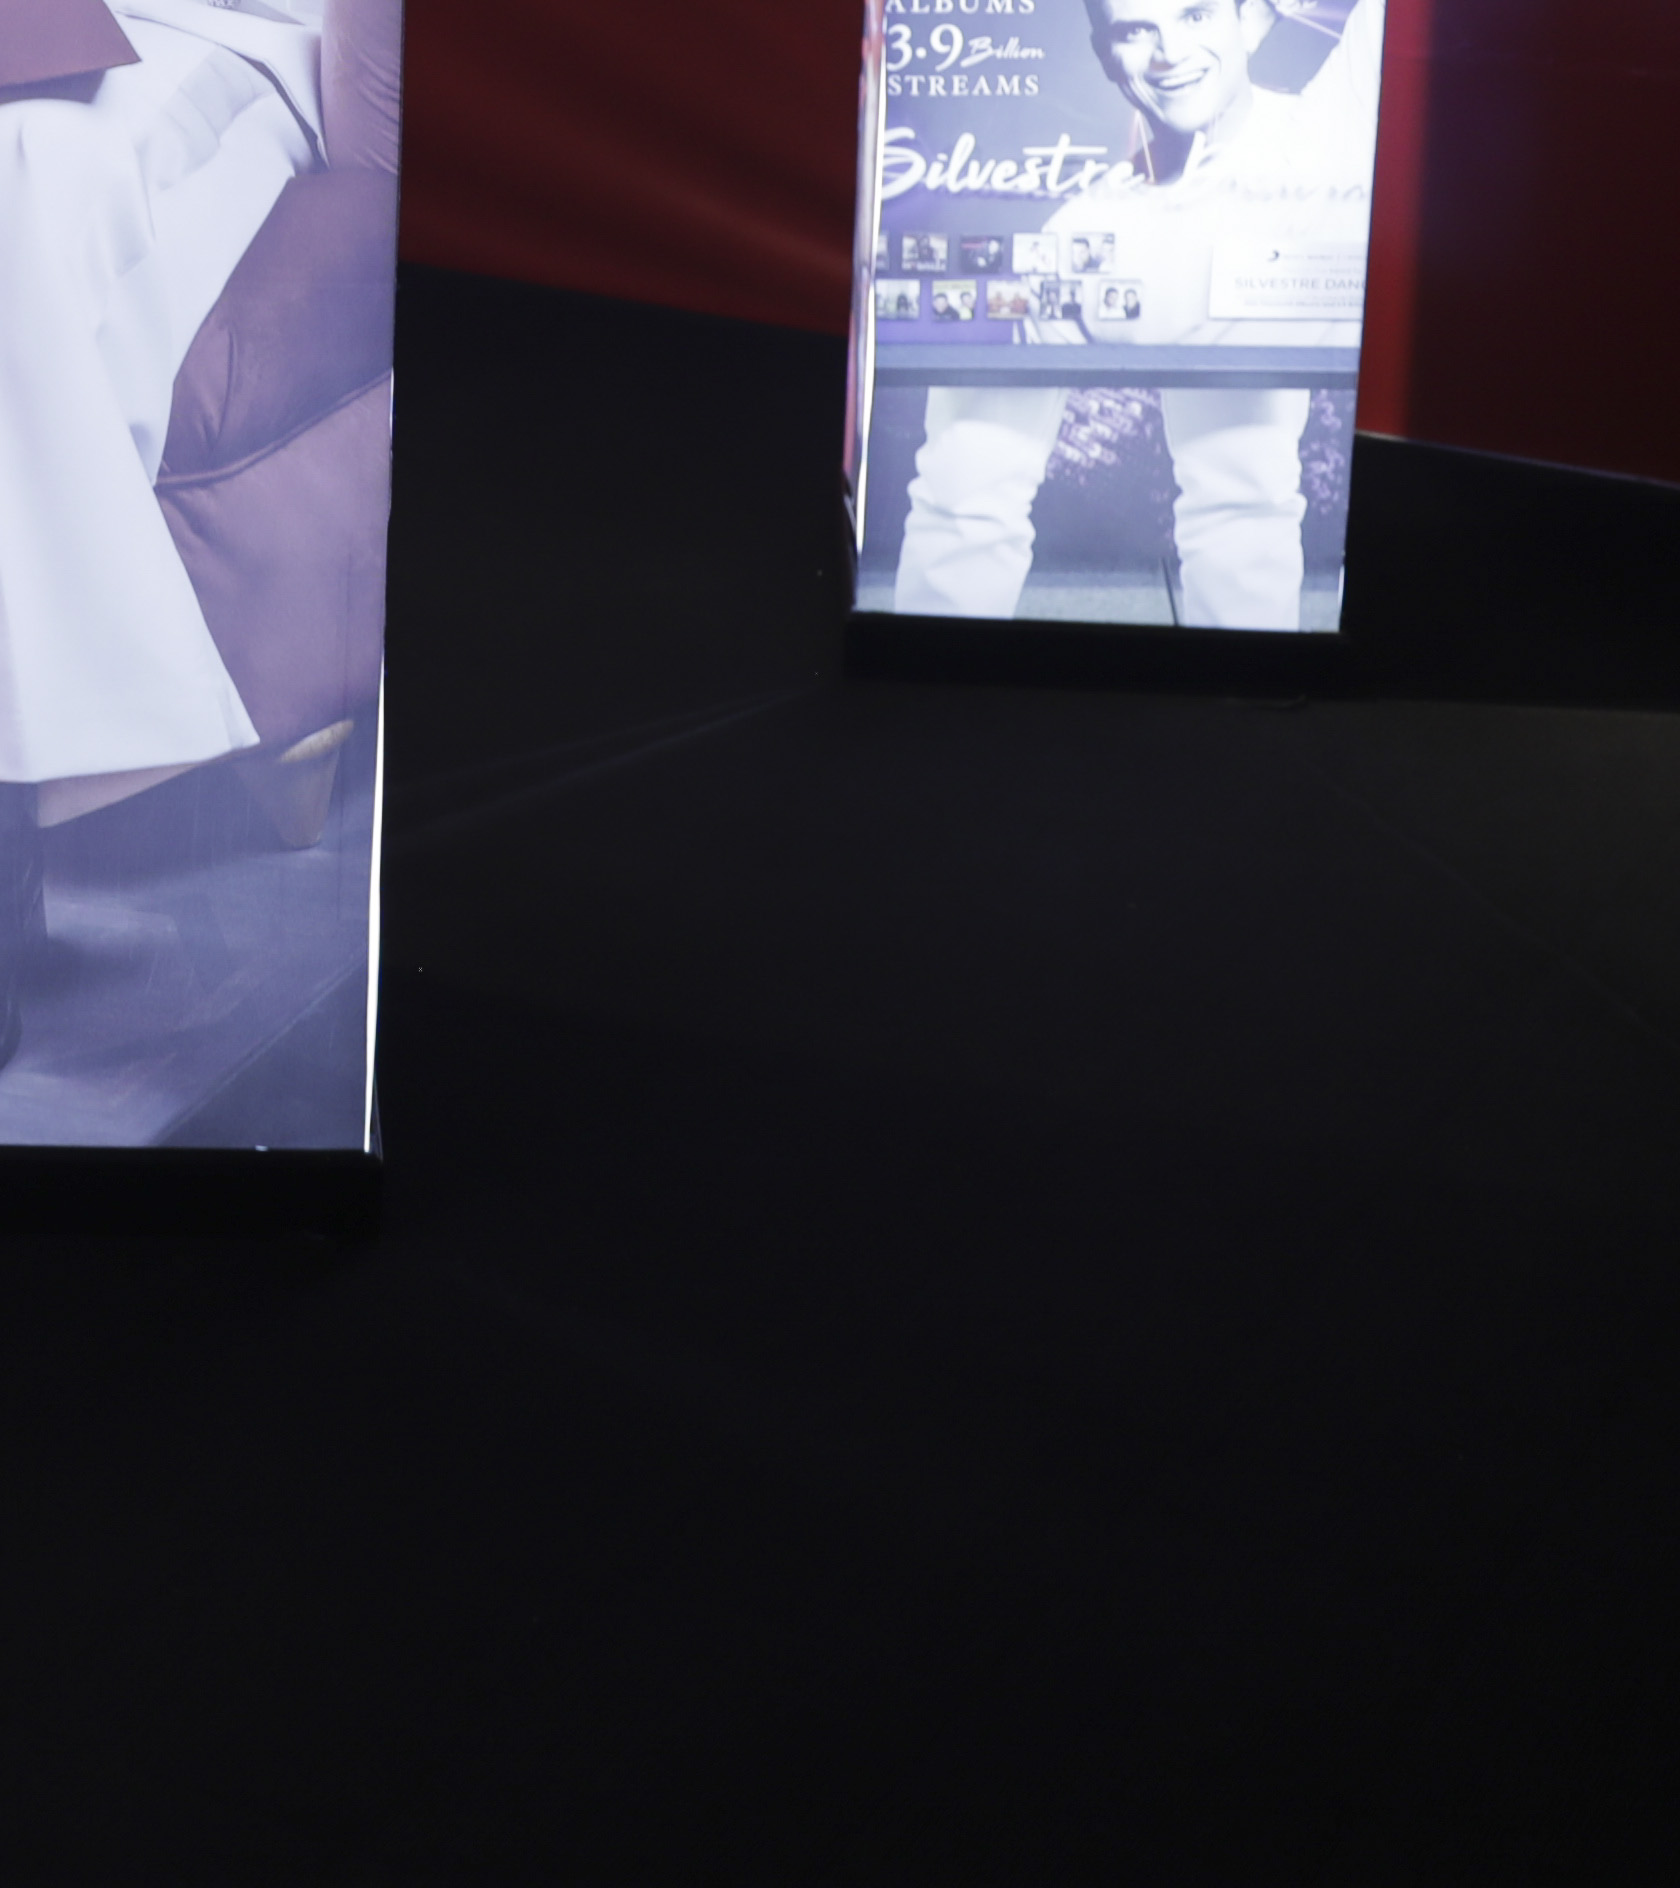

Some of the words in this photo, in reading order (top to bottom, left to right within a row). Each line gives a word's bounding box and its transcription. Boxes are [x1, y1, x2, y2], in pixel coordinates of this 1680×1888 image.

[960, 36, 1045, 68] Billion
[887, 75, 1040, 96] STREAMS
[882, 127, 1146, 201] Silvestre
[1234, 277, 1321, 290] SILVESTRE
